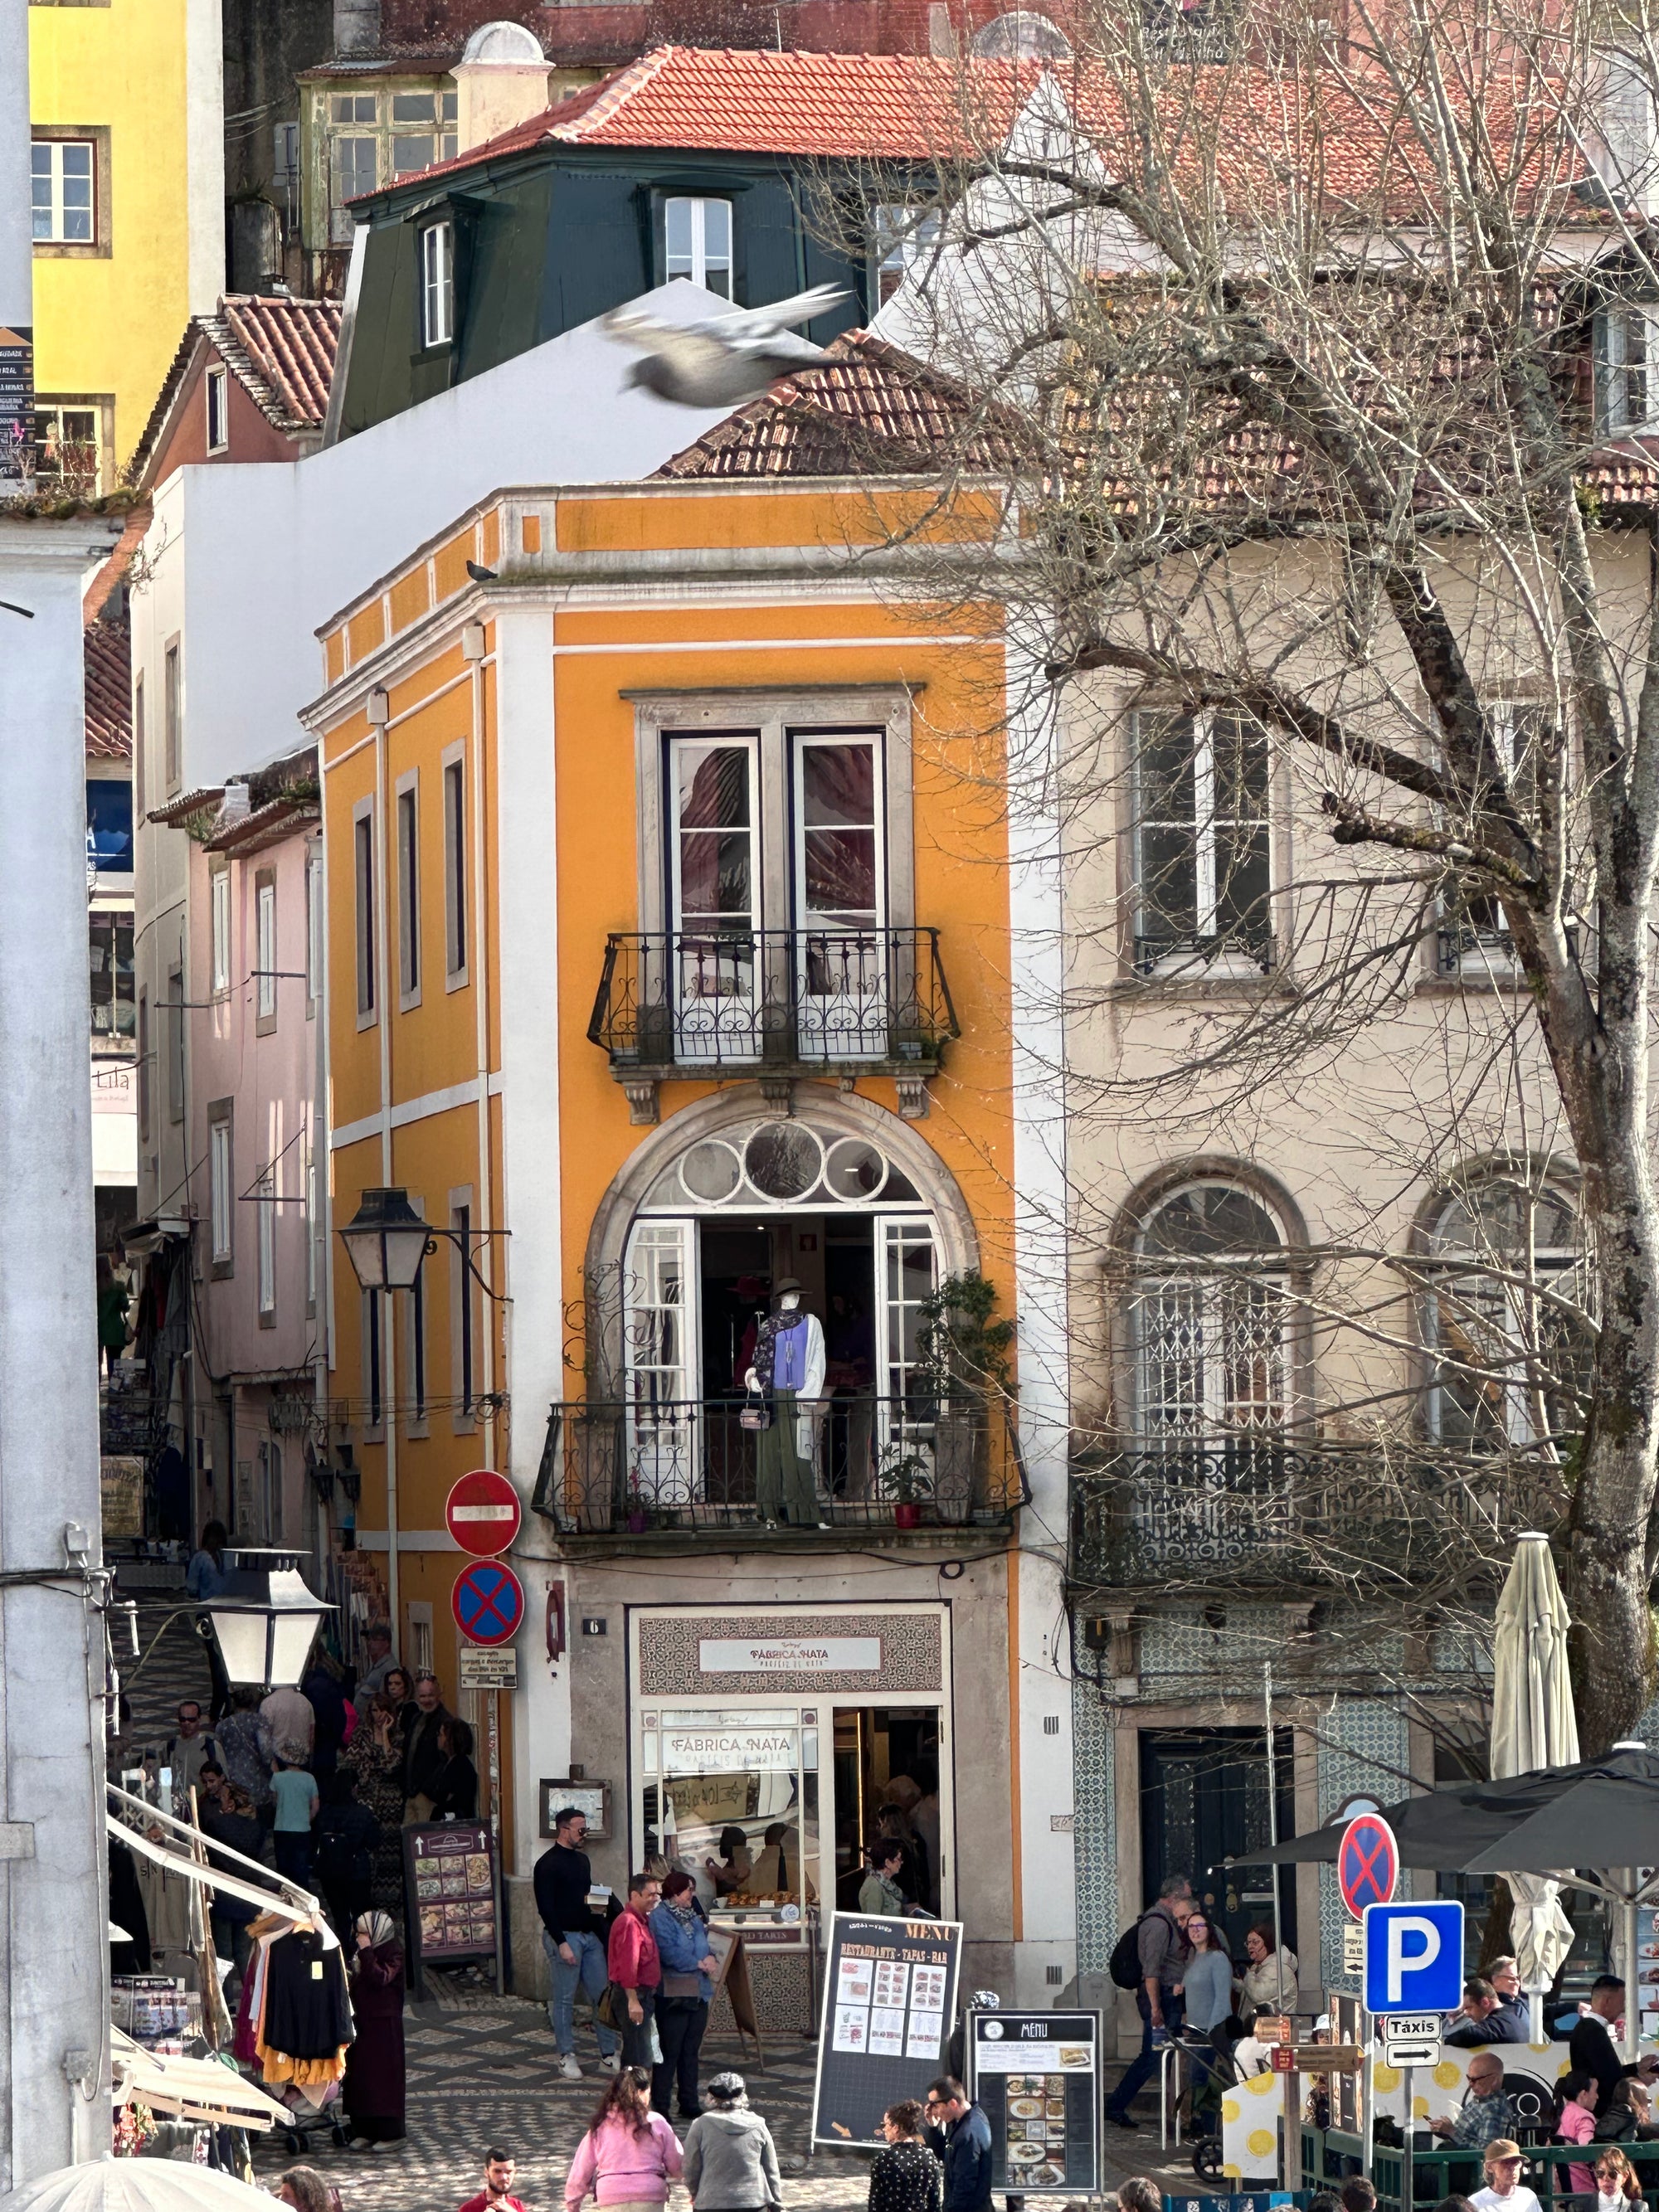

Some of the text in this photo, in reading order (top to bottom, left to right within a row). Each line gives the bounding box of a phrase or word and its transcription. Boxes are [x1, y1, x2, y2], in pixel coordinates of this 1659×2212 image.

[590, 1619, 599, 1634] 6
[747, 1736, 791, 1751] NATA
[904, 1923, 955, 1942] MENU
[902, 1948, 926, 1962] TAPAS
[1388, 1916, 1441, 2002] P
[1391, 2020, 1435, 2034] Táxis
